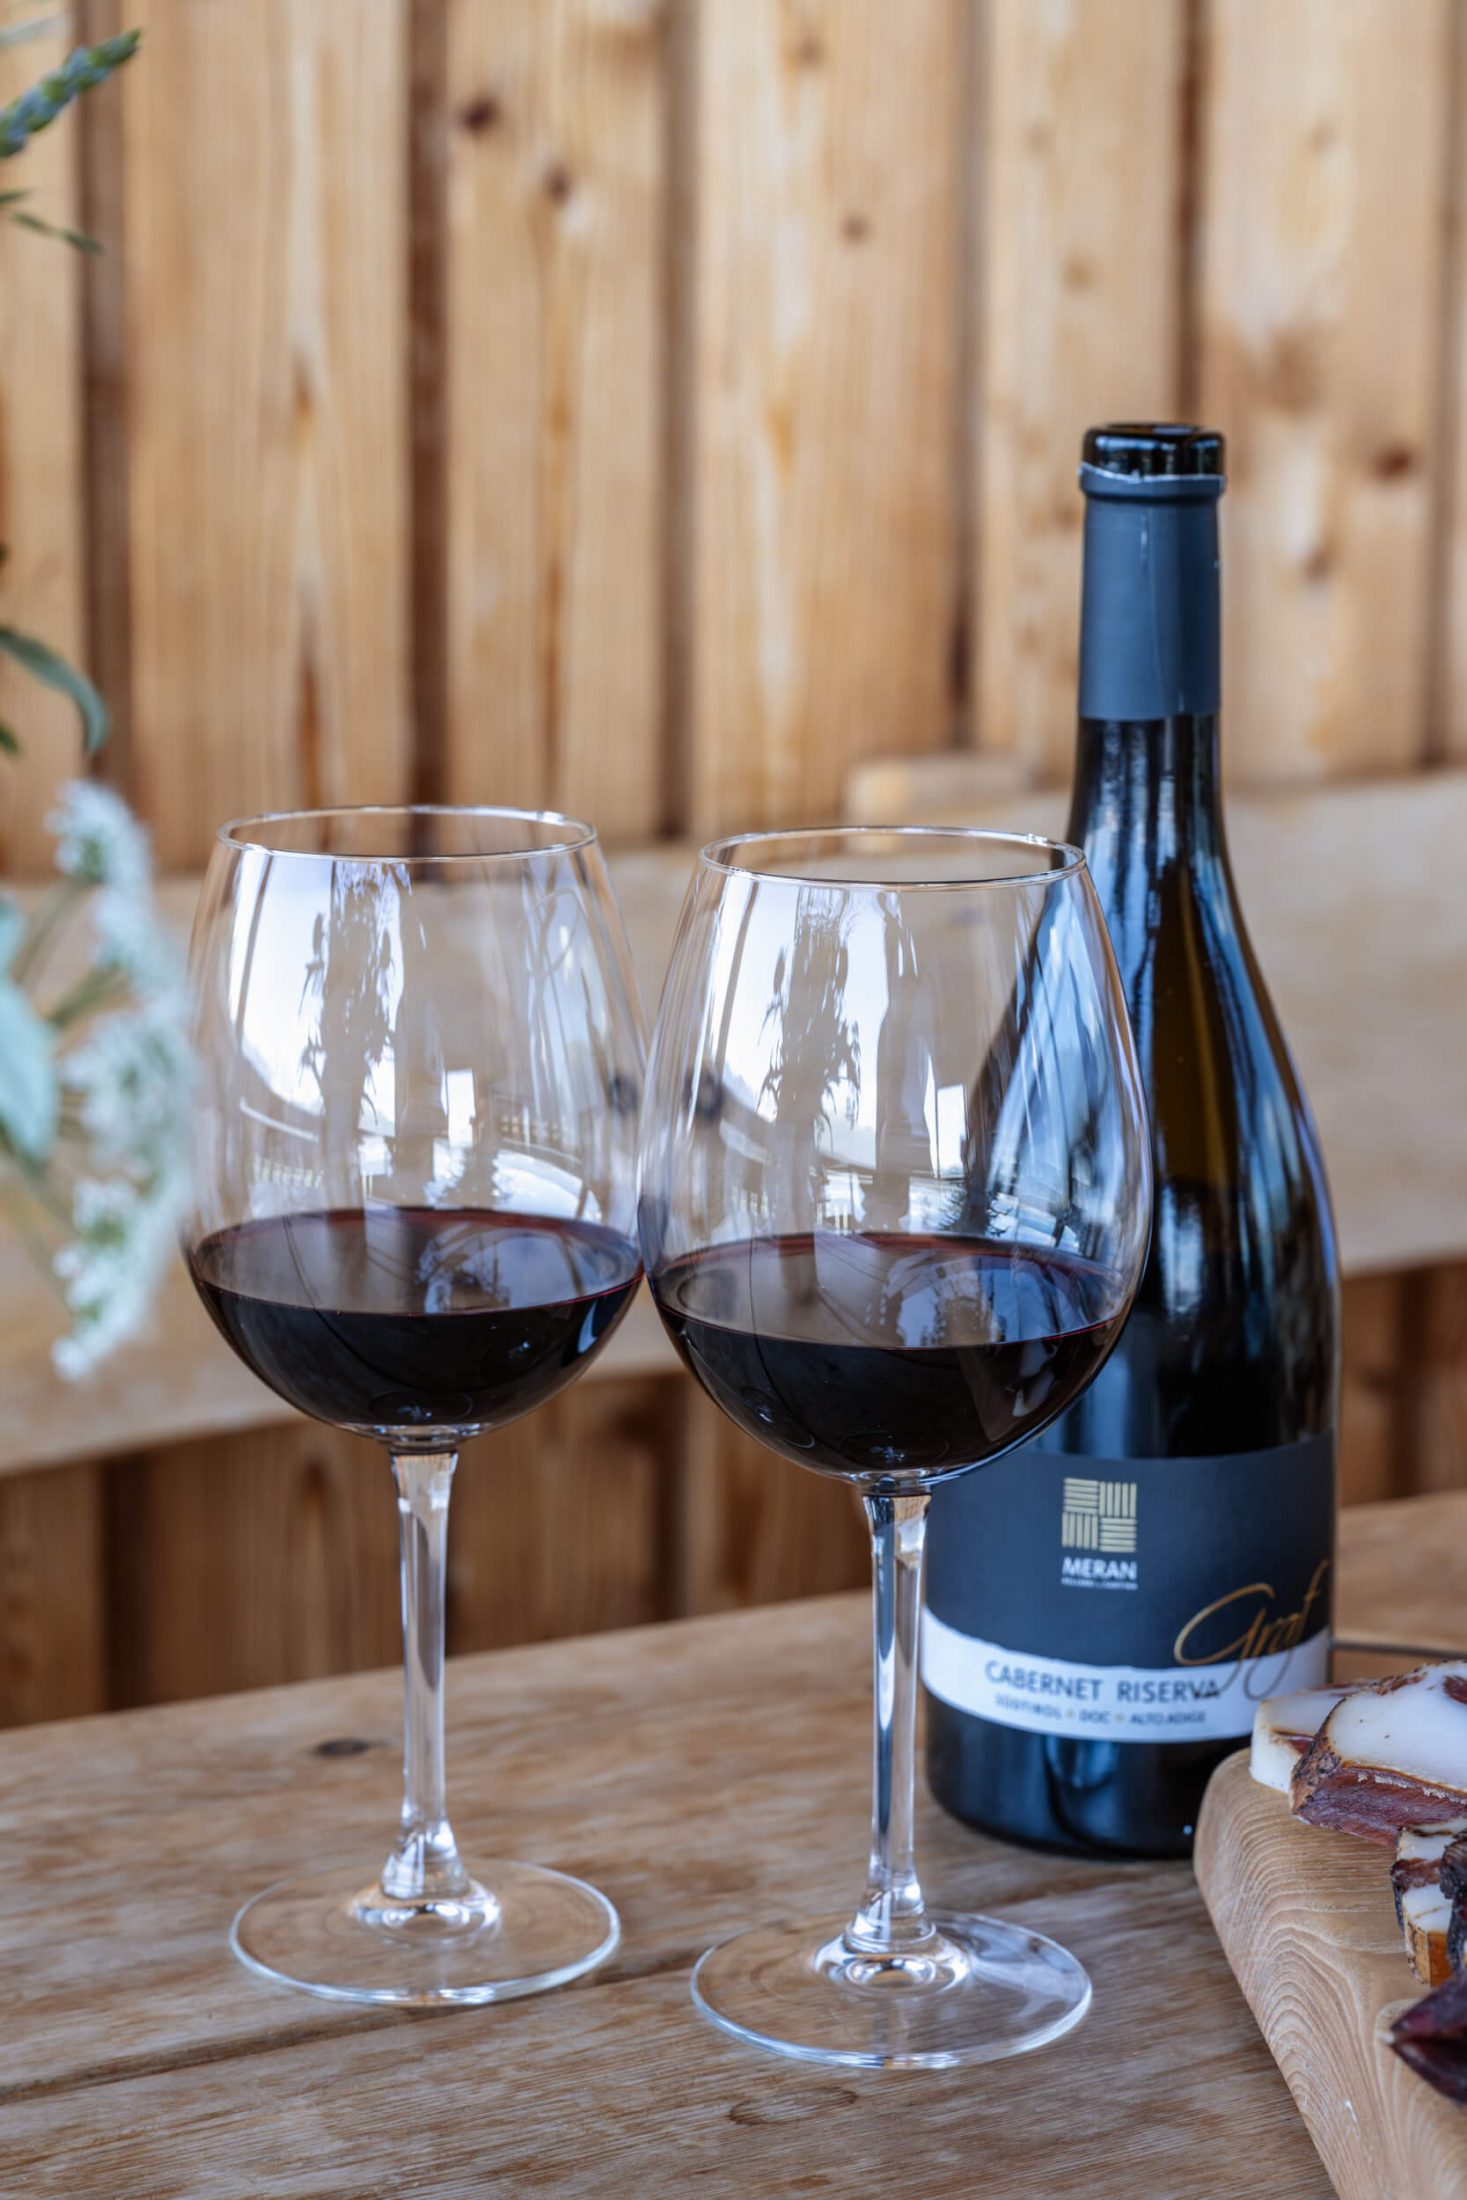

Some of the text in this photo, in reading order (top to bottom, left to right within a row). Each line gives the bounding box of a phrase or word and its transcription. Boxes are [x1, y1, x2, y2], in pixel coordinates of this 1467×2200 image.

[1062, 1556, 1138, 1580] MERAN
[985, 1660, 1220, 1703] CABERNET RISERVA
[1078, 1710, 1111, 1724] DOC
